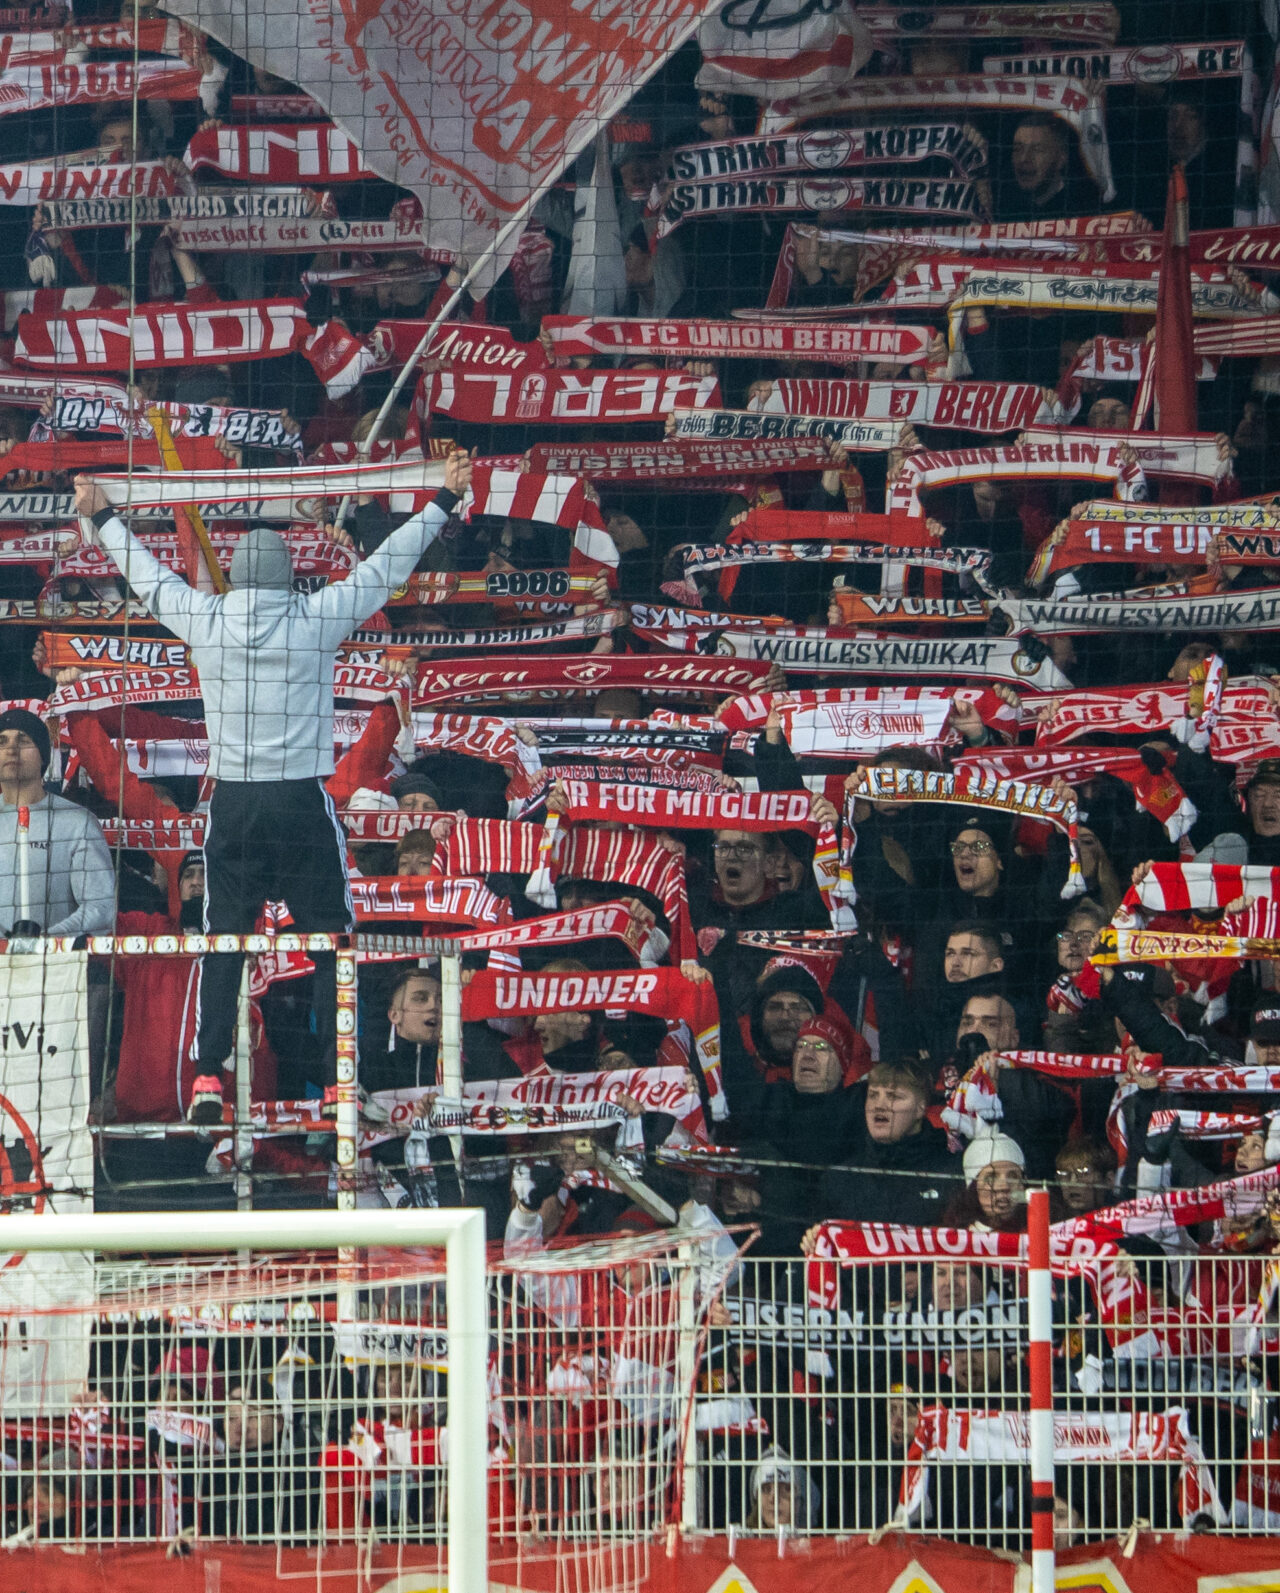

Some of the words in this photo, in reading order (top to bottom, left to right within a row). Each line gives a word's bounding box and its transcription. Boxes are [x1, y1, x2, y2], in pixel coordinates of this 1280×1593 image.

[41, 64, 140, 97] 1966
[39, 164, 177, 201] UNION
[167, 196, 228, 219] WIRD
[278, 224, 309, 242] ist
[423, 332, 527, 369] Union
[641, 326, 678, 347] FC
[688, 325, 783, 349] UNION
[794, 330, 902, 352] BERLIN
[778, 378, 869, 418] UNION
[933, 383, 1042, 428] BERLIN
[706, 413, 850, 441] BERLIN
[546, 453, 685, 471] EISERN
[699, 446, 825, 465] UNION
[1005, 443, 1100, 464] BERLIN
[1085, 526, 1114, 553] 1.
[1124, 526, 1163, 553] FC
[487, 571, 570, 598] 2006
[862, 596, 983, 617] WUHLE
[70, 637, 186, 668] WUHLE
[754, 638, 996, 667] WUHLESYNDIKAT
[428, 713, 517, 758] 1966
[883, 714, 924, 734] UNION
[666, 790, 810, 822] MITGLIED
[1129, 933, 1227, 958] UNION
[495, 973, 658, 1009] UNIONER
[865, 1222, 1000, 1258] UNION
[883, 1305, 1019, 1343] UNION
